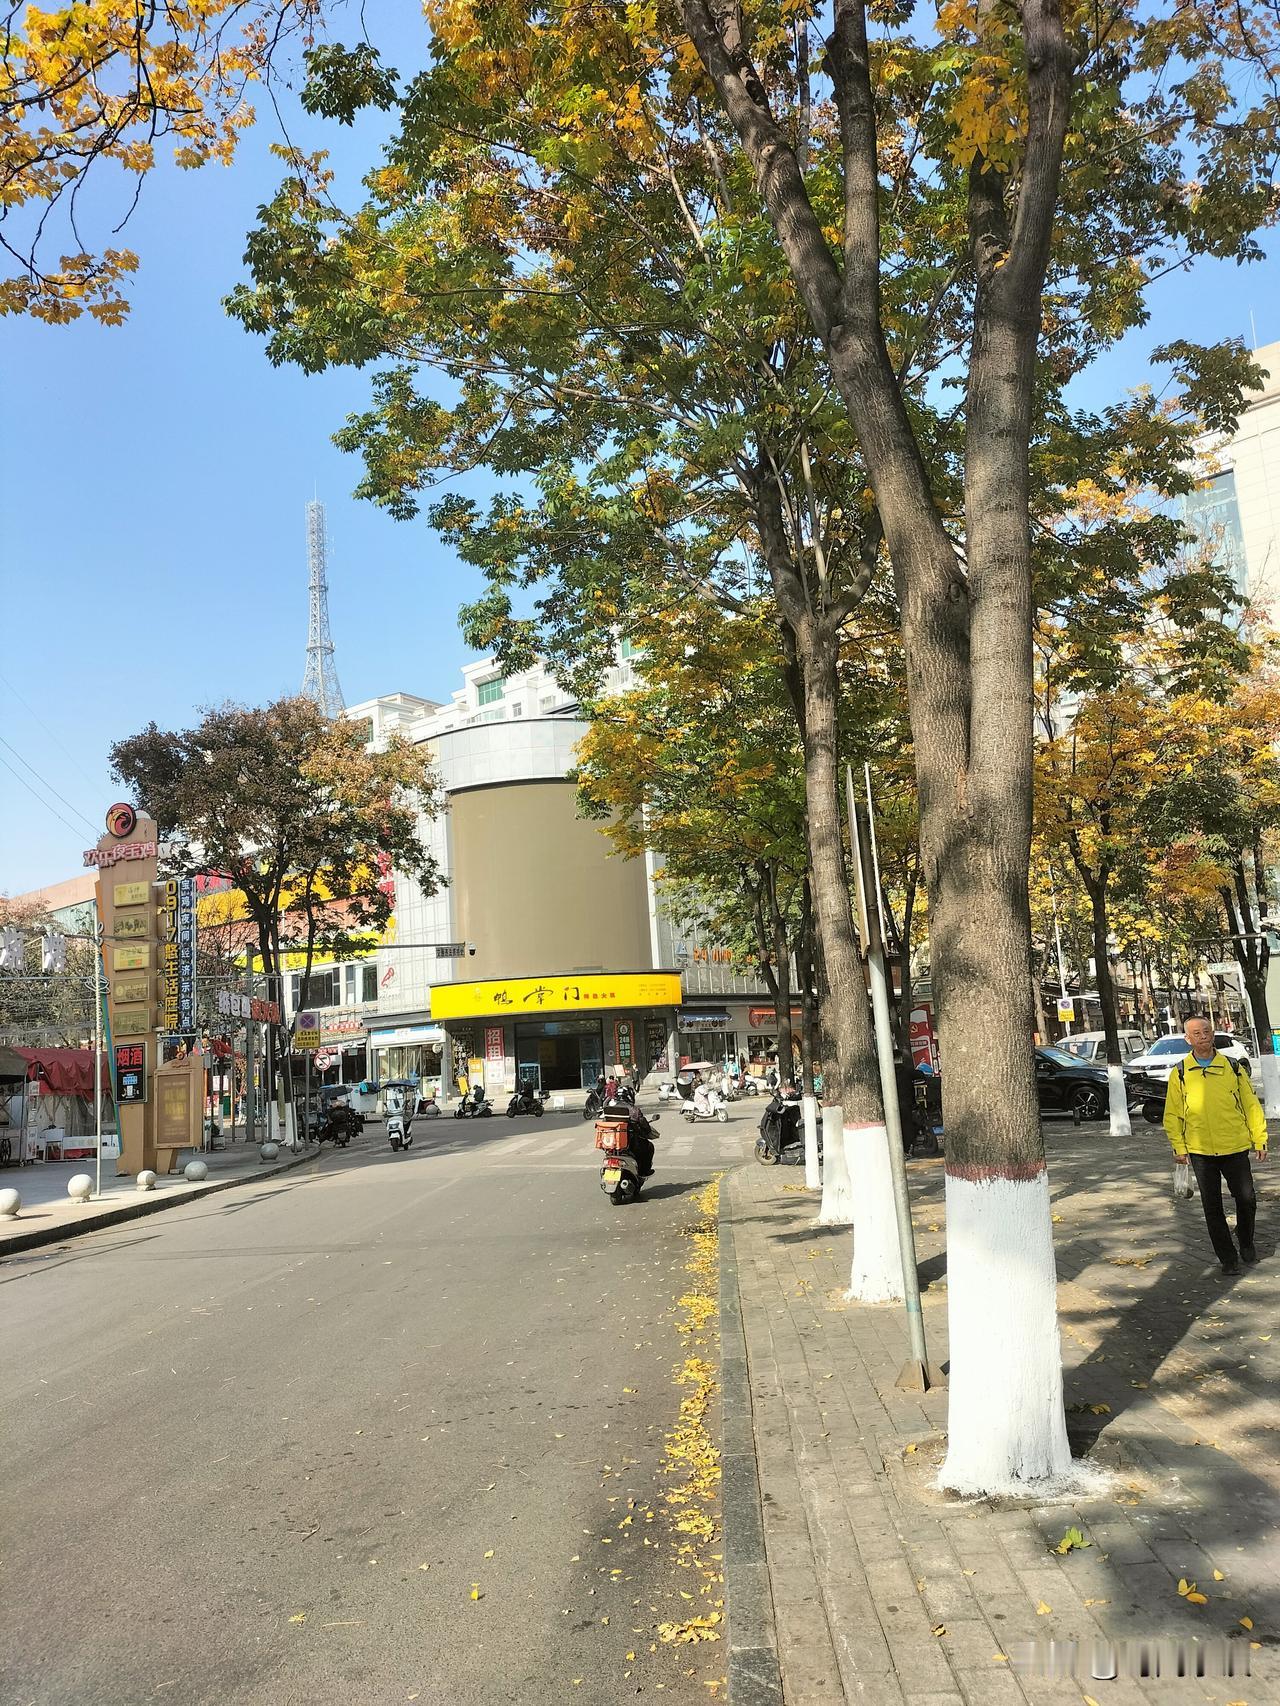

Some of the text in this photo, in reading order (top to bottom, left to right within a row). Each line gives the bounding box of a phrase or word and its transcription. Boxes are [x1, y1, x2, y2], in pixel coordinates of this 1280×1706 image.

[83, 841, 157, 867] 欢乐夜宝鸡
[180, 879, 193, 1028] 宝鸡夜间经济示范点
[117, 1047, 143, 1067] 烟酒
[487, 1029, 501, 1059] 招租
